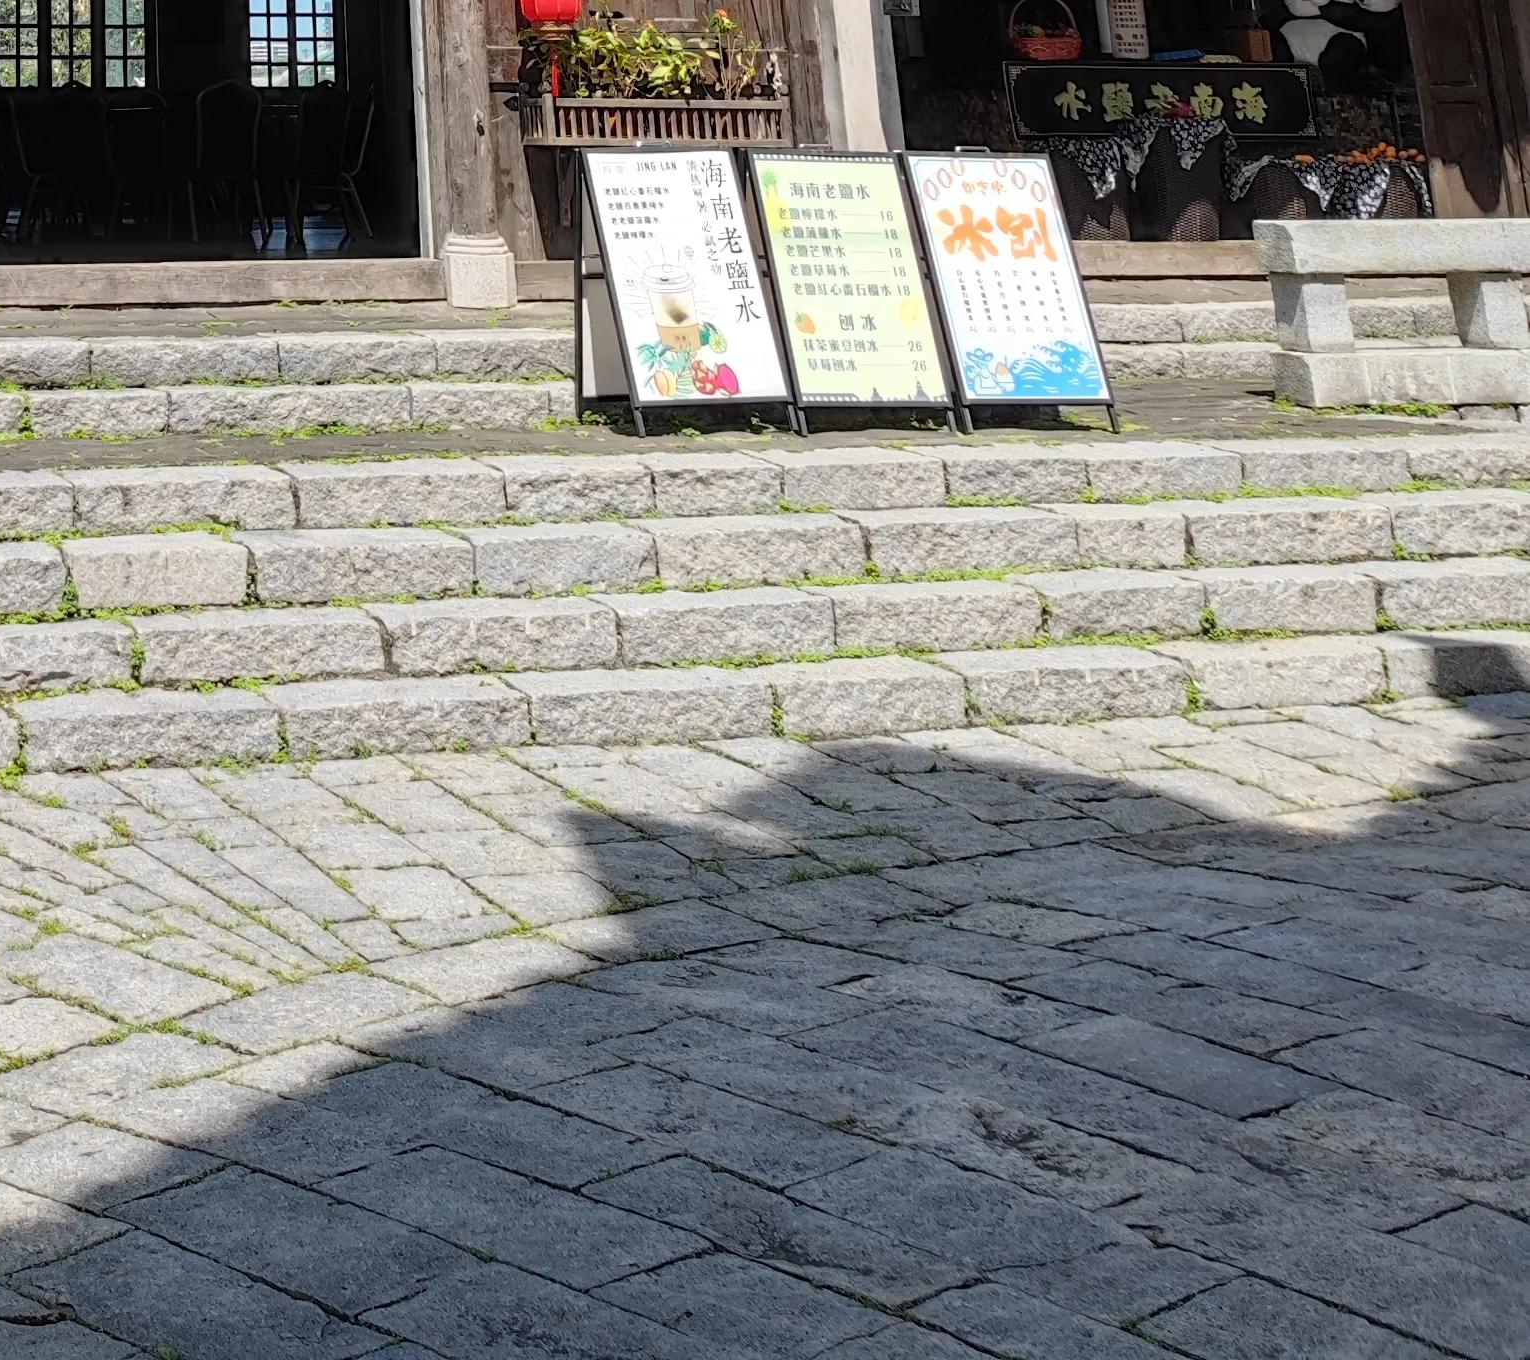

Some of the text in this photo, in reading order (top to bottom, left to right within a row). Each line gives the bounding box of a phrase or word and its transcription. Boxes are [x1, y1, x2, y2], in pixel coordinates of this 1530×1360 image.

[636, 161, 657, 172] JING
[660, 161, 678, 171] LAN
[789, 182, 871, 200] 海南老鹽水
[880, 210, 894, 222] 16
[884, 228, 898, 240] 18
[700, 158, 762, 324] 海南老鹽水
[888, 247, 902, 259] 18
[893, 266, 906, 278] 18
[897, 284, 911, 296] 18
[907, 340, 923, 352] 26
[912, 360, 927, 372] 26
